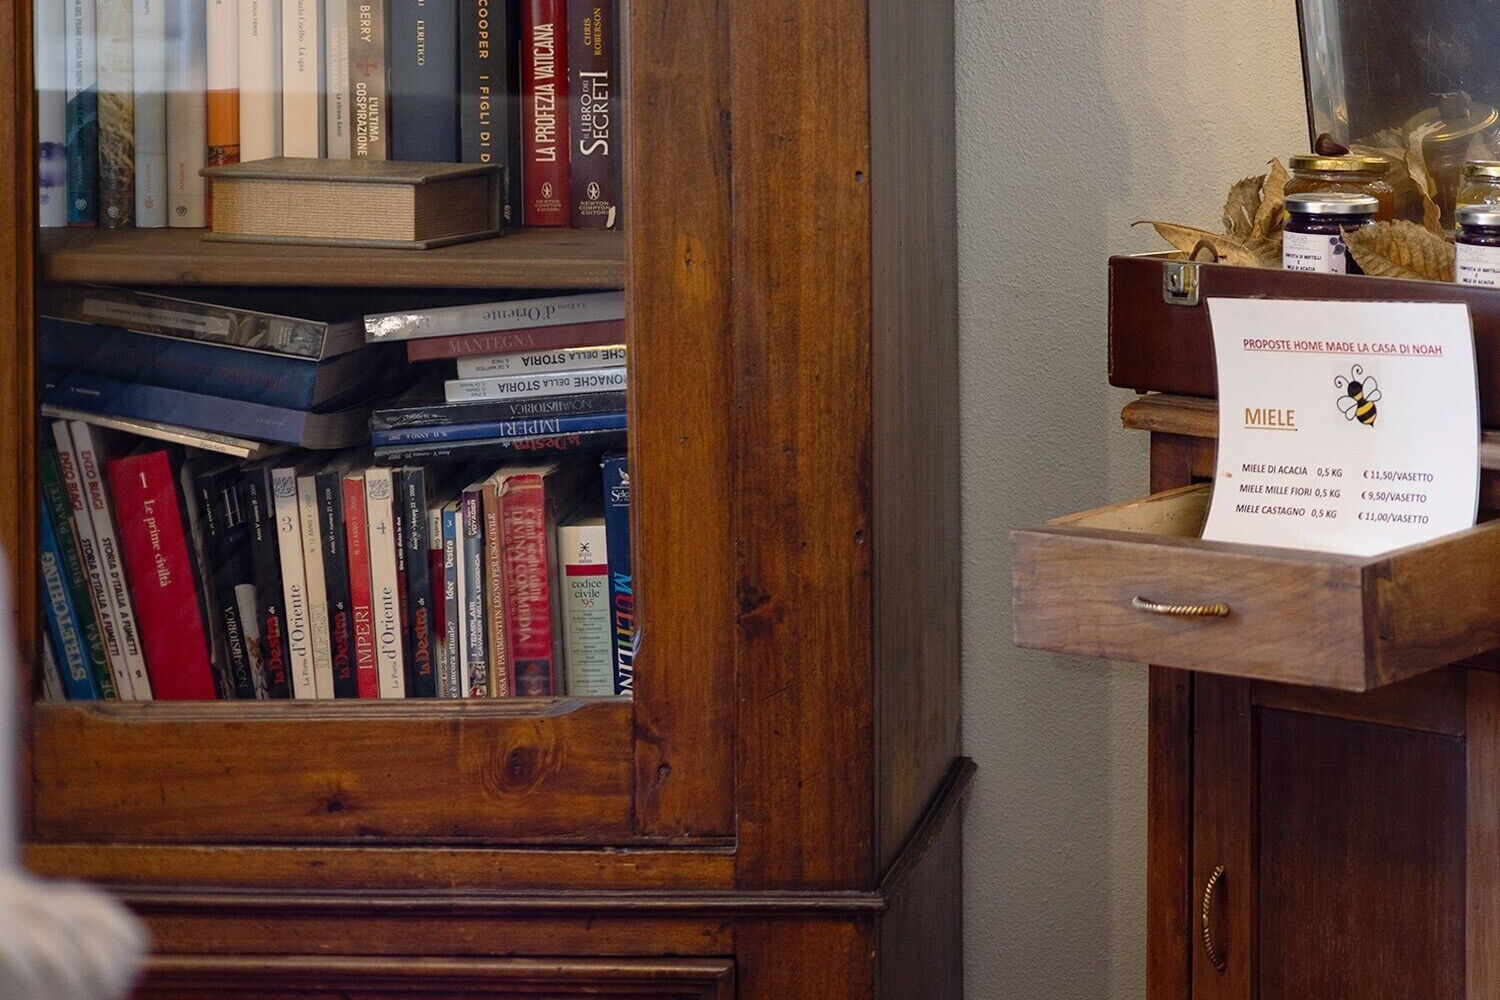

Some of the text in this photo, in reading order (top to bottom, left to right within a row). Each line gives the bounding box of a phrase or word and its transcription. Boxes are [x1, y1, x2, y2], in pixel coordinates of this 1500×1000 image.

[359, 5, 372, 43] BERRY
[584, 18, 592, 45] CHRIS
[593, 7, 602, 56] ROBERSON
[75, 38, 83, 59] PIEDRA
[298, 47, 305, 57] La
[416, 20, 425, 66] L'ERETICO
[75, 70, 83, 86] SONO
[296, 59, 305, 72] spia
[480, 86, 490, 126] FIGLI
[534, 23, 556, 162] LA PROFEZIA VATICANA
[356, 82, 369, 156] COSPIRAZIONE
[368, 97, 379, 142] L'ULTIMA
[579, 71, 609, 155] SEGRETI
[581, 96, 592, 132] LIBRO
[480, 132, 490, 147] DI
[483, 305, 555, 320] d'Oriente
[449, 334, 535, 353] MANTEGNA
[521, 351, 598, 366] DELLA STORIA
[1243, 339, 1443, 355] PROPOSTE HOME MADE LA CASA DI NOAH
[498, 378, 570, 393] DELLA STORIA
[499, 418, 560, 436] IMPERI
[1245, 408, 1295, 427] MIELE
[513, 436, 566, 451] Destra
[60, 452, 75, 480] ENZO
[81, 450, 97, 479] ENZO
[139, 472, 147, 489] 1
[1242, 464, 1433, 483] MIELE DI ACACIA 0,5 KG € 11,50/VASETTO
[66, 483, 82, 511] BIAGI
[87, 482, 103, 511] BIAGI
[1239, 484, 1427, 503] MIELE MILLE FIORI 0,5 KG € 9,50/VASETTO
[307, 520, 315, 537] ANNO
[1236, 504, 1429, 525] MIELE CASTAGNO 0,5 KG € 11,00/VASETTO
[81, 538, 96, 571] STORIA
[102, 537, 118, 570] STORIA
[142, 500, 171, 588] Le prime civiltà
[444, 540, 454, 600] Idee Destra
[511, 510, 531, 642] DIVINA COMMEDIA
[572, 579, 601, 588] codice
[89, 573, 106, 609] D'ITALIA
[110, 572, 126, 609] D'ITALIA
[488, 513, 506, 676] DI PAVIMENTI IN LEGNO PER USO CIVILE
[575, 588, 600, 598] civile
[581, 599, 595, 607] '95
[41, 551, 87, 681] STRETCHING
[469, 601, 477, 648] TEMPLARI
[103, 620, 120, 656] FUMETTI
[122, 620, 138, 656] FUMETTI
[266, 616, 281, 668] Destra
[289, 584, 310, 686] La d'Oriente
[311, 603, 330, 669] IMPERI
[334, 612, 348, 667] Destra
[355, 605, 373, 669] IMPERI
[381, 587, 399, 689] La Porta d'Oriente
[415, 608, 431, 675] la Destra
[448, 621, 456, 654] attuale?
